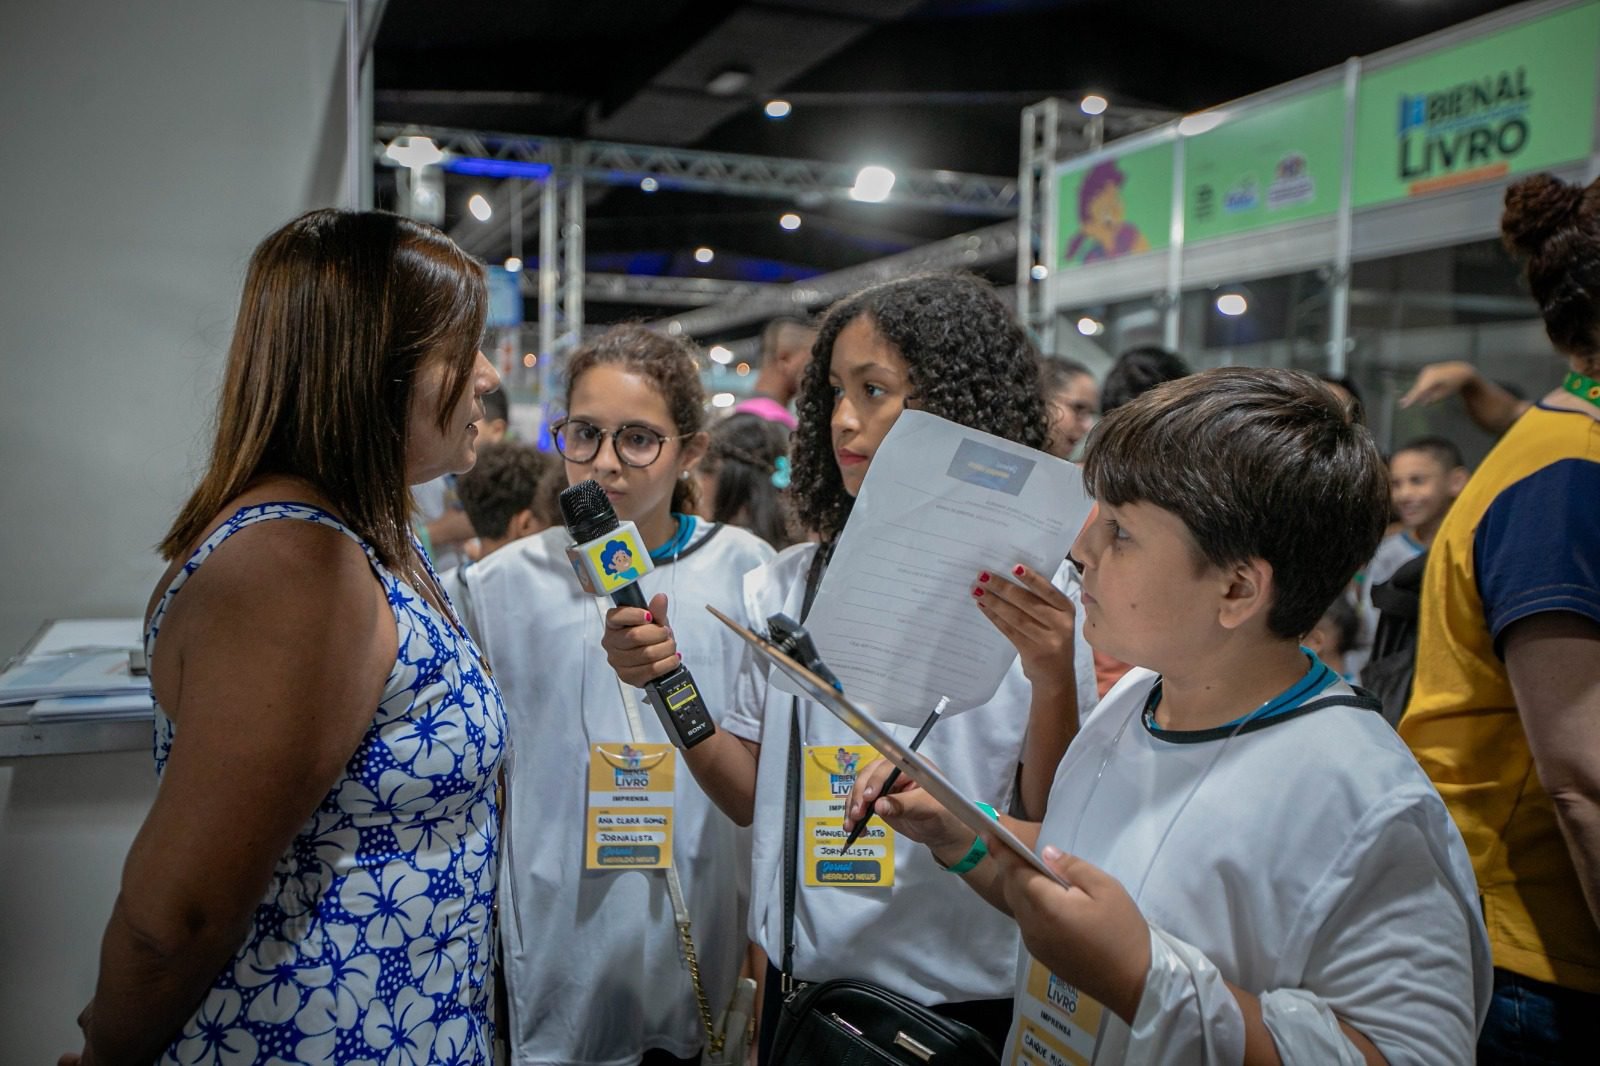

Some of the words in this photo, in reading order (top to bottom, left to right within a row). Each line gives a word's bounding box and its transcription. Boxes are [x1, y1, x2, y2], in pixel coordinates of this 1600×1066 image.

[1427, 66, 1533, 124] BIENAL
[1399, 117, 1529, 181] LIVRO
[688, 722, 706, 736] SONY
[615, 776, 649, 786] LIVRO
[831, 783, 853, 795] LIV
[598, 816, 613, 825] ANA
[616, 817, 640, 825] CLARA
[600, 833, 653, 843] JORNALISTA
[815, 829, 850, 838] MANUELL
[1047, 982, 1077, 1013] LIVRO
